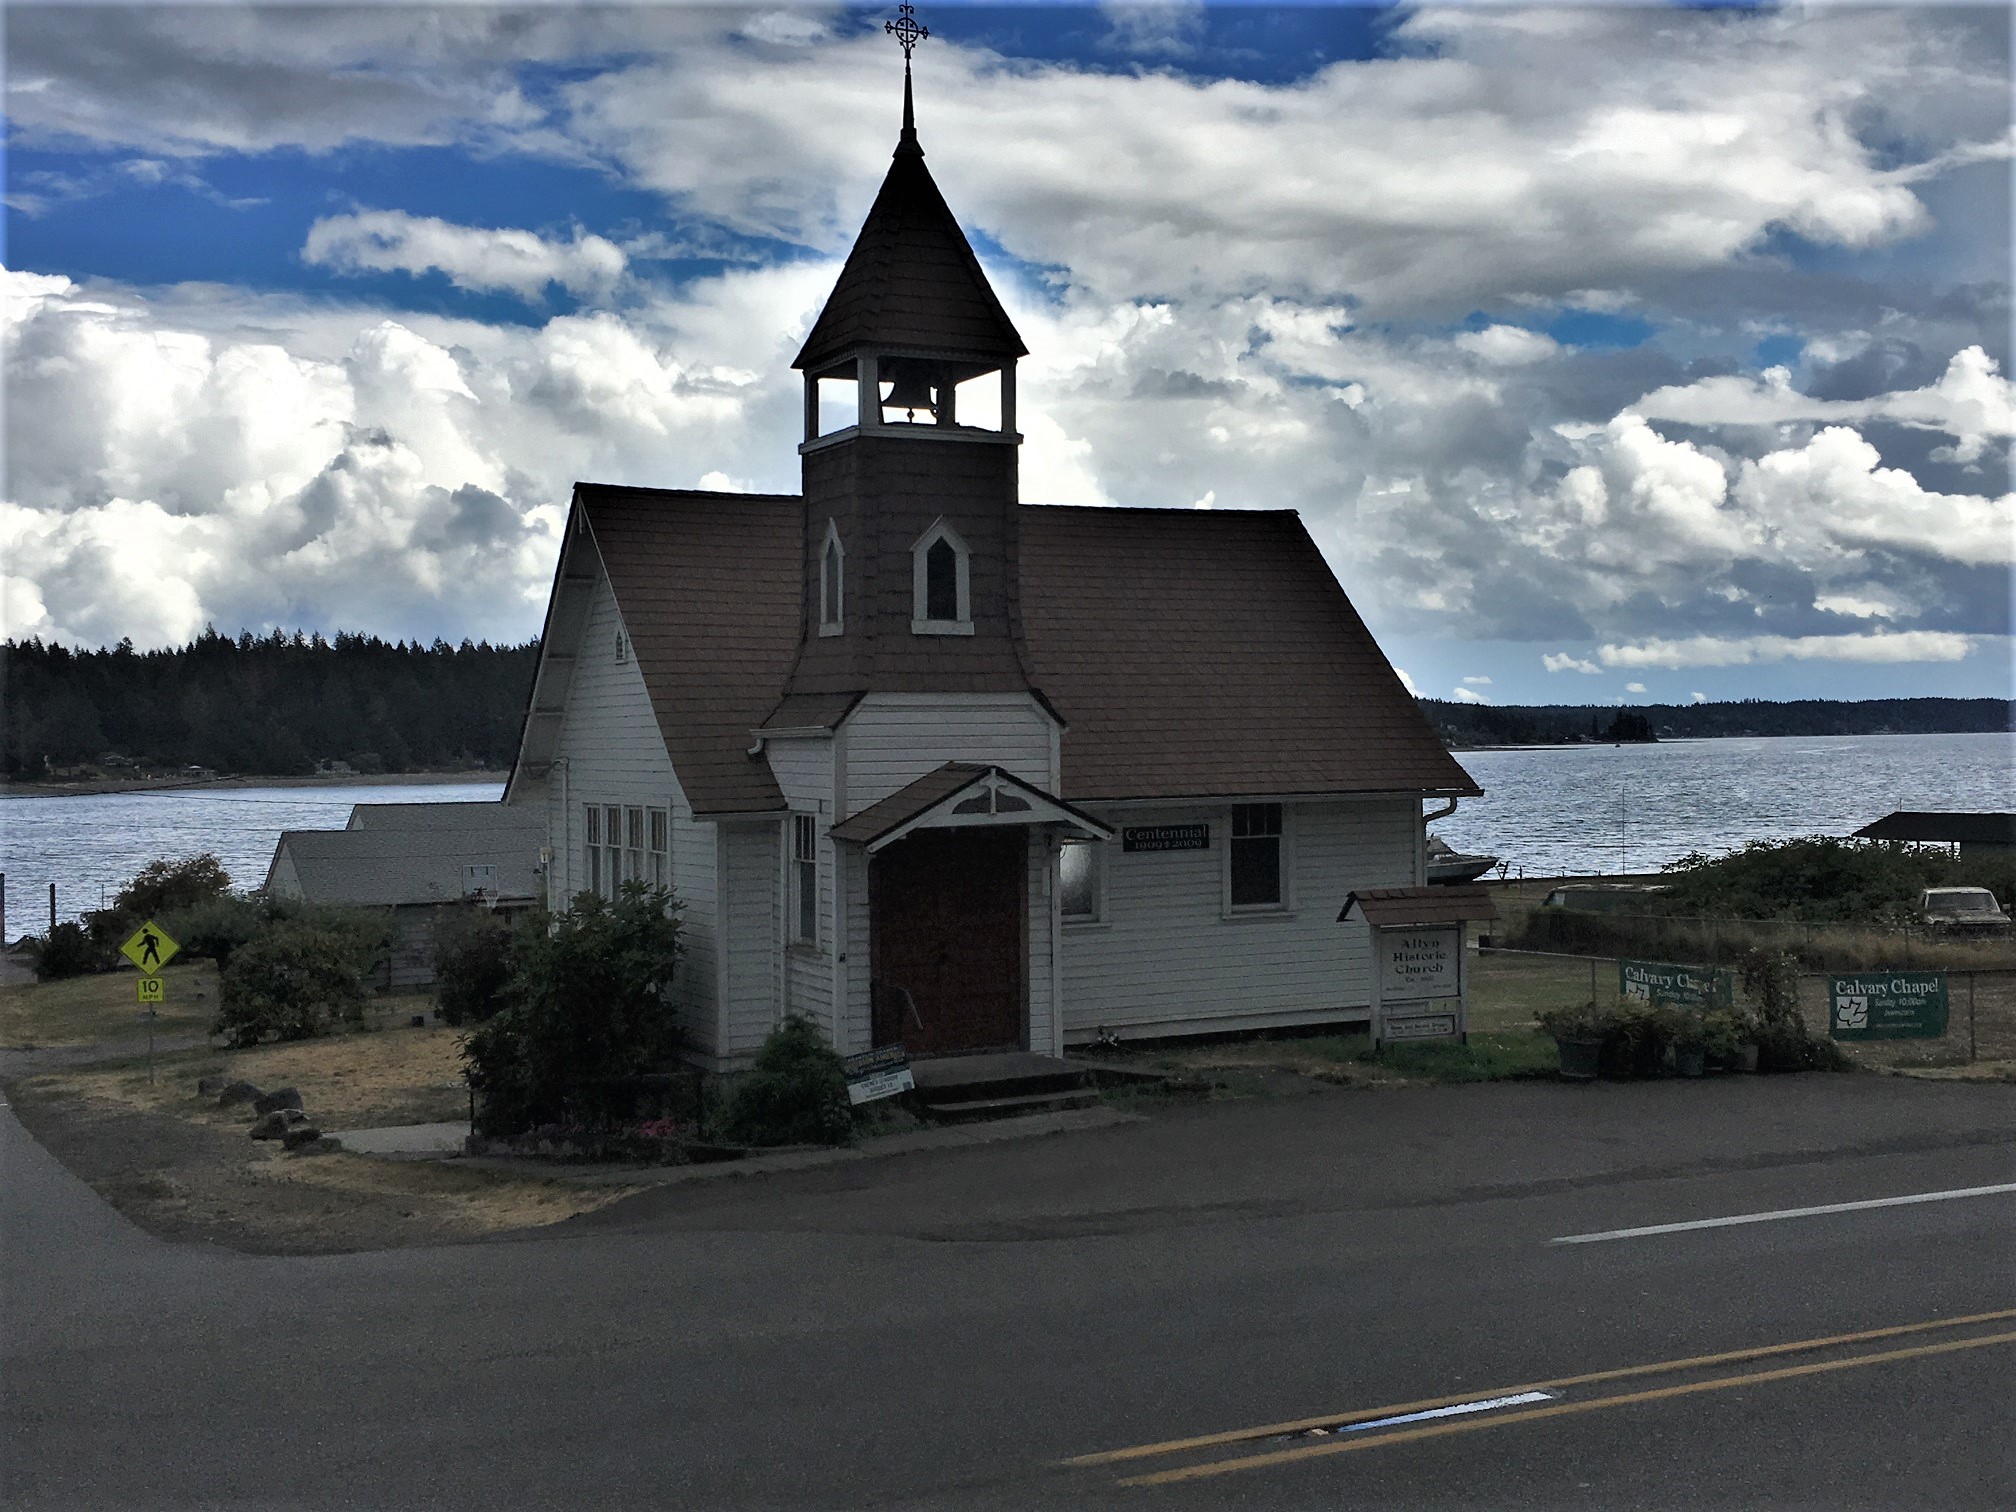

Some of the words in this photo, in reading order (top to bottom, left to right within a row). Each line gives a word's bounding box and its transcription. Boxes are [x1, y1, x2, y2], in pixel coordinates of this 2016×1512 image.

[1126, 825, 1206, 840] Centennial
[1135, 840, 1162, 849] 1909
[1172, 839, 1202, 849] 2009
[1401, 938, 1440, 950] Allyn
[1393, 951, 1446, 962] Historic
[1395, 963, 1443, 974] Church
[1625, 966, 1674, 989] Calvary
[1677, 973, 1719, 995] Chael
[142, 980, 159, 993] 10
[1836, 980, 1888, 997] Calvary
[1891, 978, 1939, 996] Chapel
[1656, 989, 1681, 999] Sunday
[1875, 998, 1896, 1008] Sunday
